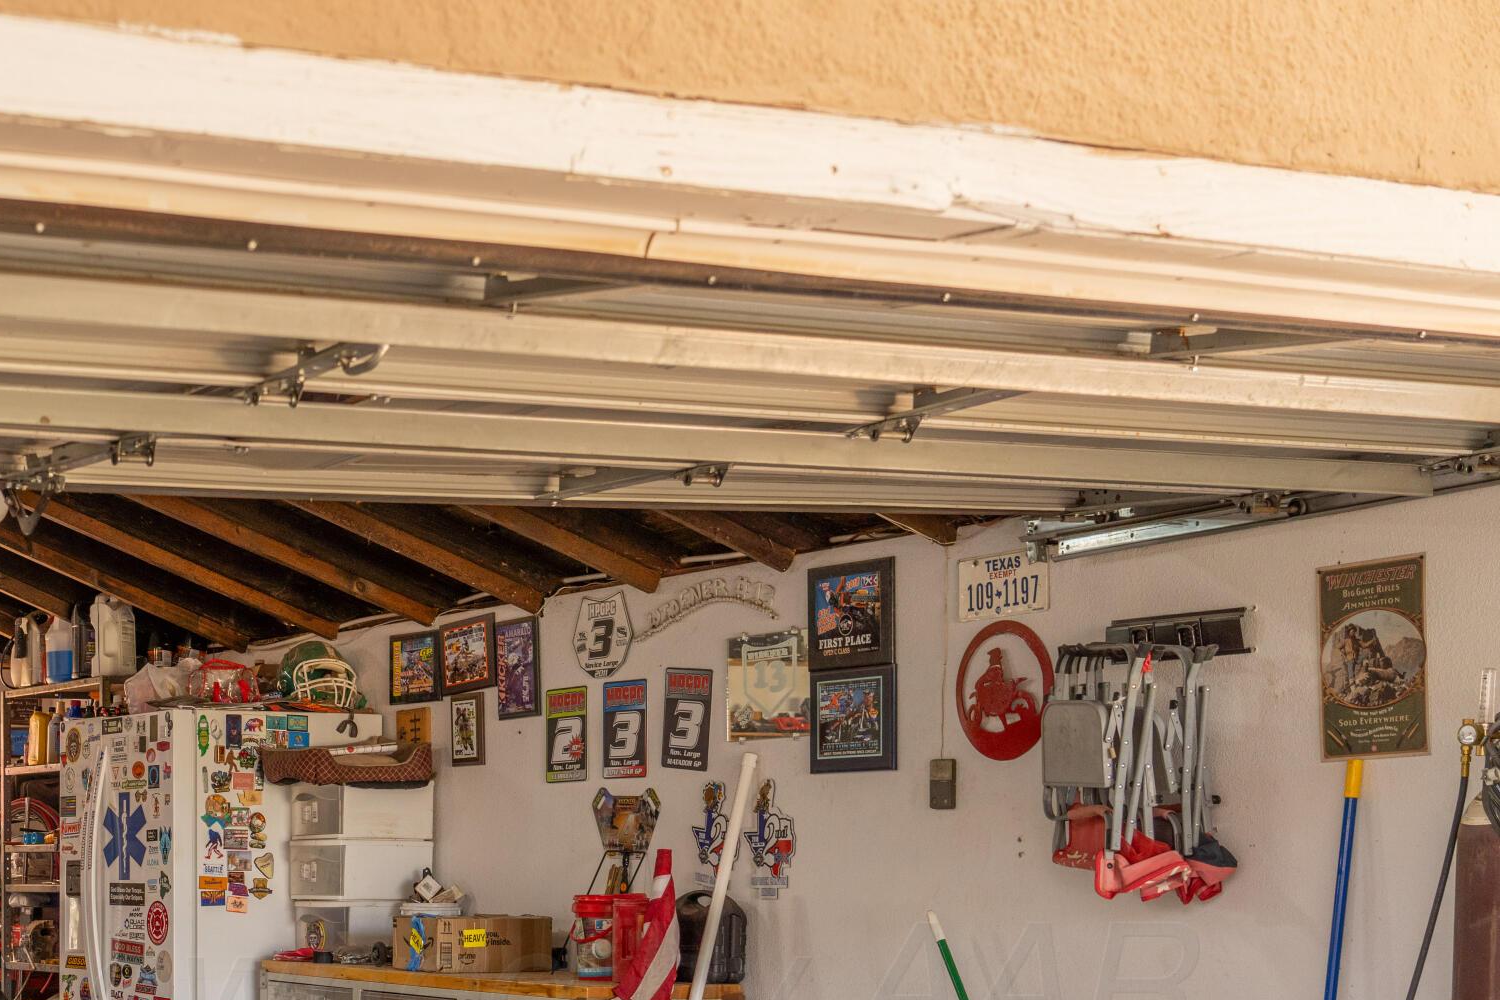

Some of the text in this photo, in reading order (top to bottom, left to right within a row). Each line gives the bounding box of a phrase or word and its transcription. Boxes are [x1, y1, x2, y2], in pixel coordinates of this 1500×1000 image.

[985, 556, 1021, 572] TEXAS
[989, 569, 1017, 580] EXEMPT
[1326, 564, 1417, 592] WINCHESTER
[1342, 597, 1401, 611] AMMUNITION
[505, 627, 532, 638] AMARILLO
[588, 618, 615, 660] 3
[818, 633, 872, 649] FIRST PLACE
[498, 635, 506, 691] KICKER
[753, 660, 787, 692] 13
[668, 700, 705, 750] 3
[1338, 715, 1410, 727] SOLD EVERYWHERE
[551, 716, 583, 765] 2
[609, 711, 642, 759] 3
[683, 750, 701, 759] Large
[565, 763, 581, 771] Large
[623, 759, 640, 767] Large
[666, 758, 692, 767] MATADOR
[464, 933, 486, 943] HEAVY
[457, 952, 477, 961] prime
